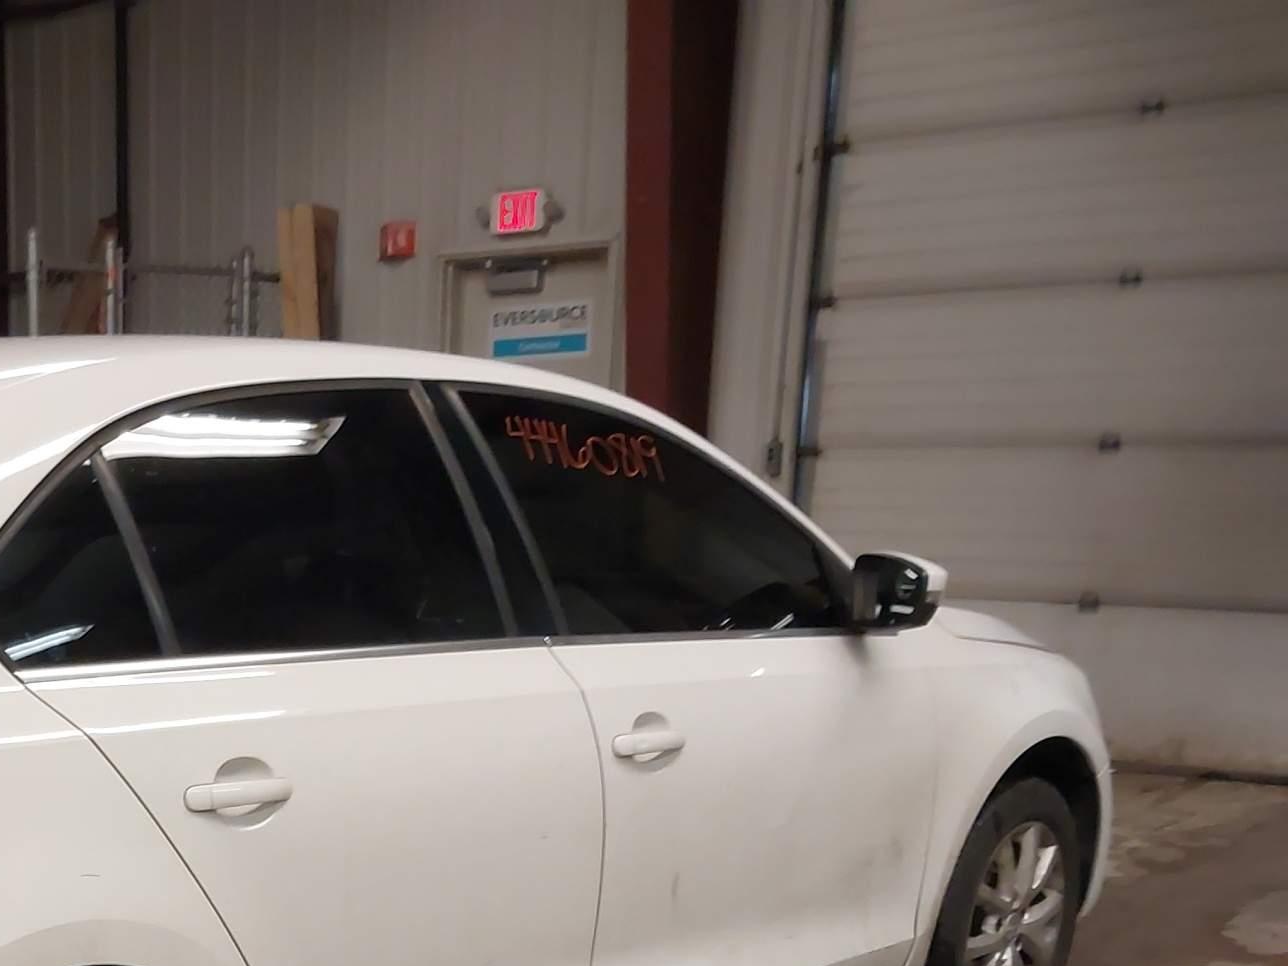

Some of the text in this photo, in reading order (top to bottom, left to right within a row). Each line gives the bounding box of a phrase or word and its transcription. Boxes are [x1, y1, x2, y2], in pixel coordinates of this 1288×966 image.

[499, 191, 537, 231] EXIT
[492, 304, 587, 329] EVERSOURCE
[505, 415, 664, 482] 44460819
